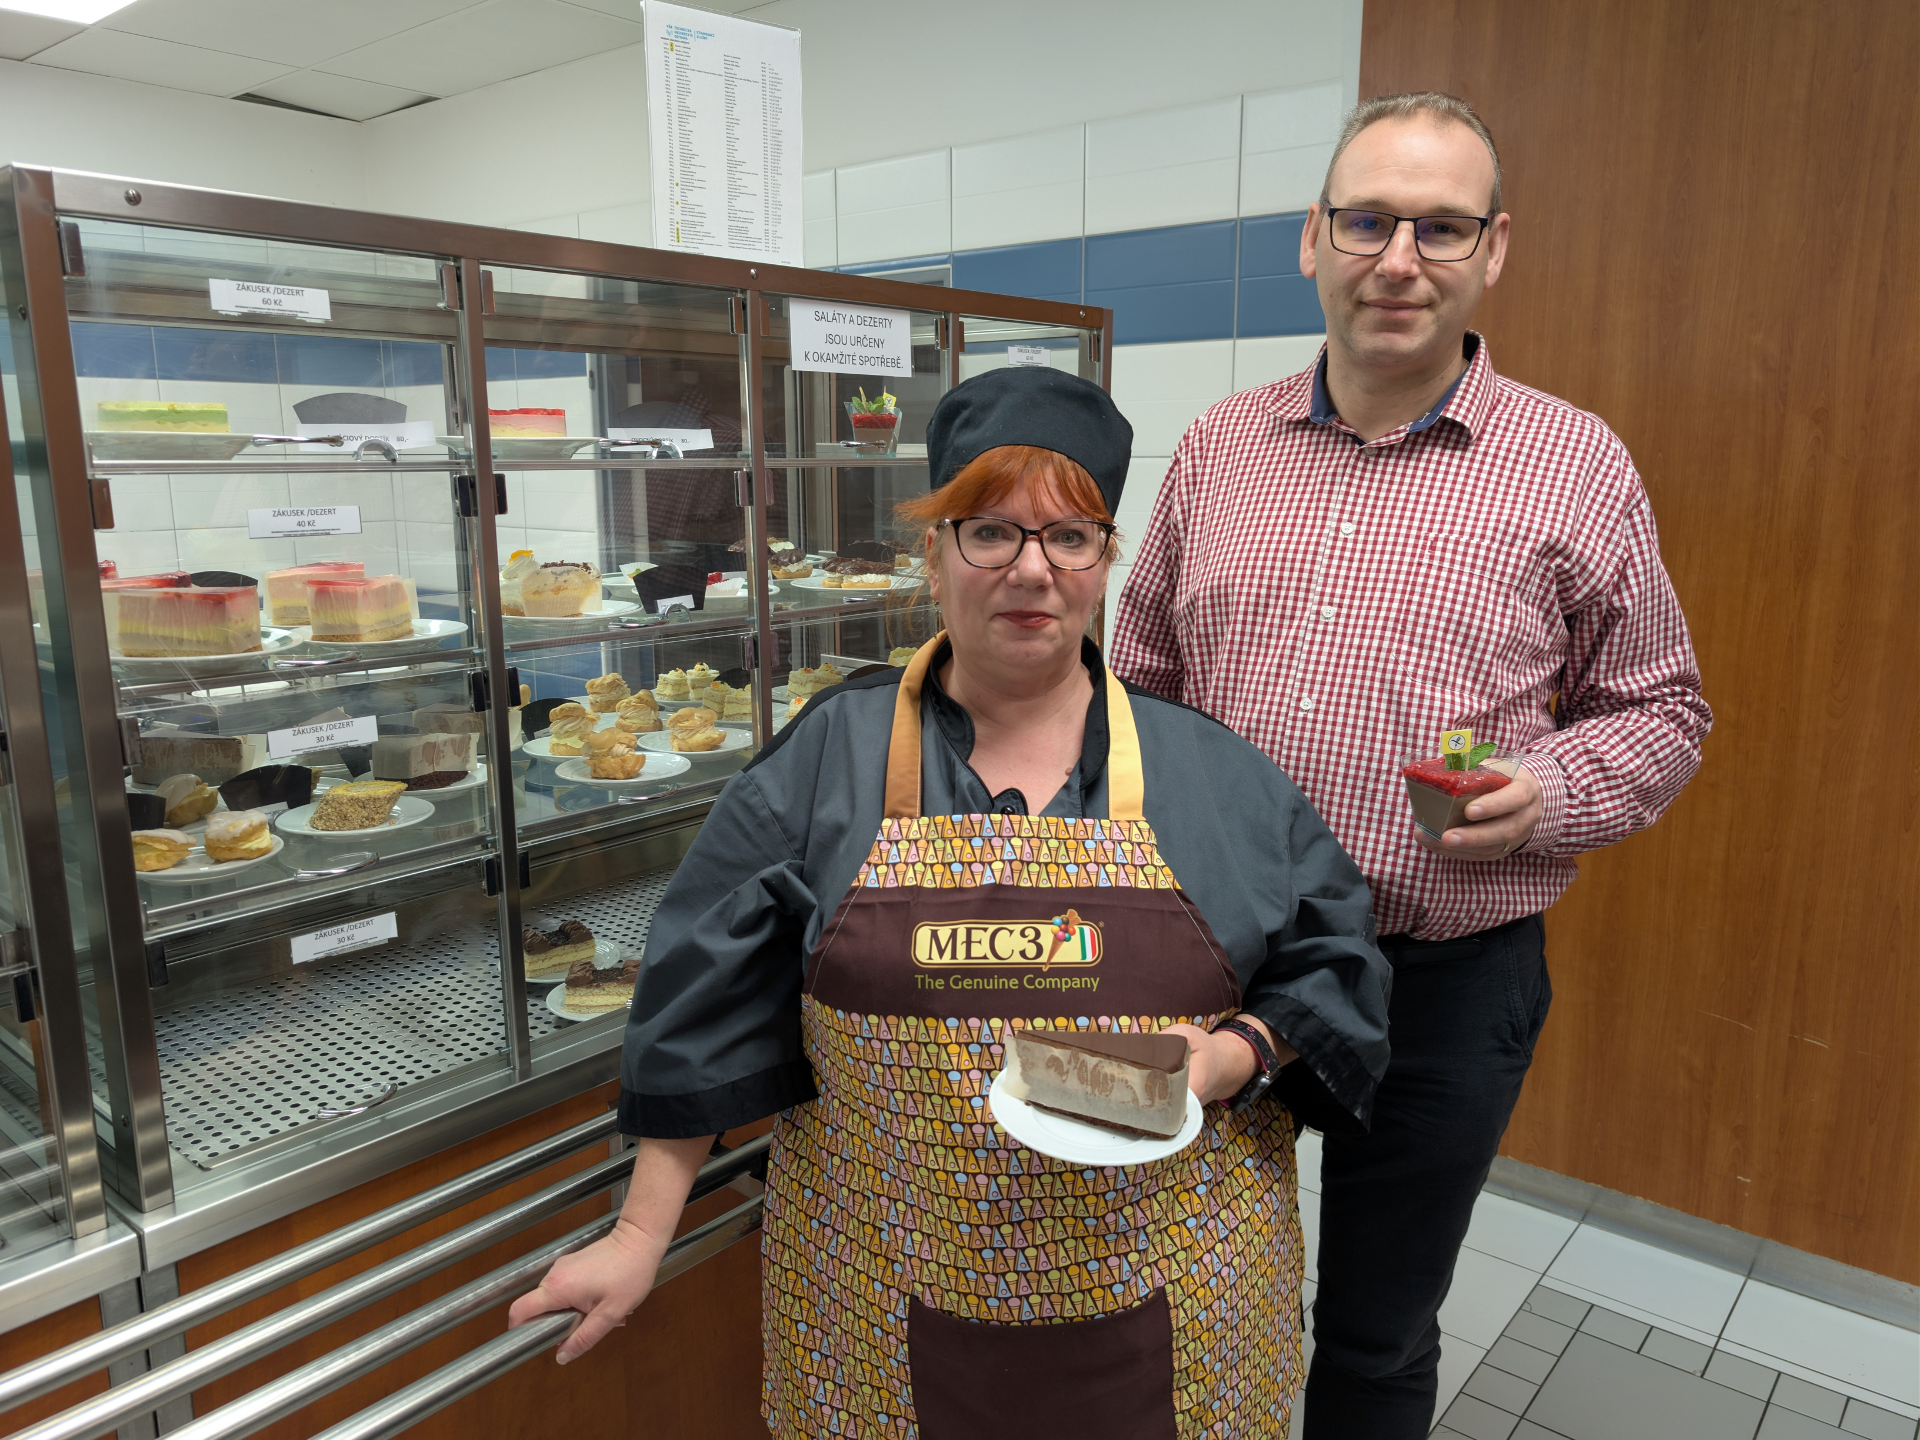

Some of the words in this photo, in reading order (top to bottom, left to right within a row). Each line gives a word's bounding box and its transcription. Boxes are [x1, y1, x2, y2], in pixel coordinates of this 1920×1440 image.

[236, 282, 271, 294] ZÁKUSEK
[273, 287, 305, 296] /DEZERT
[274, 298, 282, 306] Kč
[814, 310, 847, 324] SALÁTY
[848, 314, 855, 326] A
[857, 315, 892, 329] DEZERTY
[824, 334, 847, 346] JSOU
[850, 334, 885, 349] URČENY
[804, 351, 810, 362] K
[812, 352, 856, 366] OKAMŽITÉ
[858, 354, 904, 369] SPOTŘEBĚ.
[272, 508, 305, 518] ZÁKUSEK
[307, 508, 336, 517] /DEZERT
[292, 725, 324, 736] ZÁKUSEK
[326, 720, 354, 732] /DEZERT
[314, 926, 345, 940] ZÁKUSEK
[346, 919, 374, 933] /DEZERT
[336, 936, 345, 944] 30
[926, 926, 1044, 960] MEC3
[914, 974, 945, 990] The
[949, 974, 1019, 990] Genuine
[1023, 974, 1100, 992] Company
